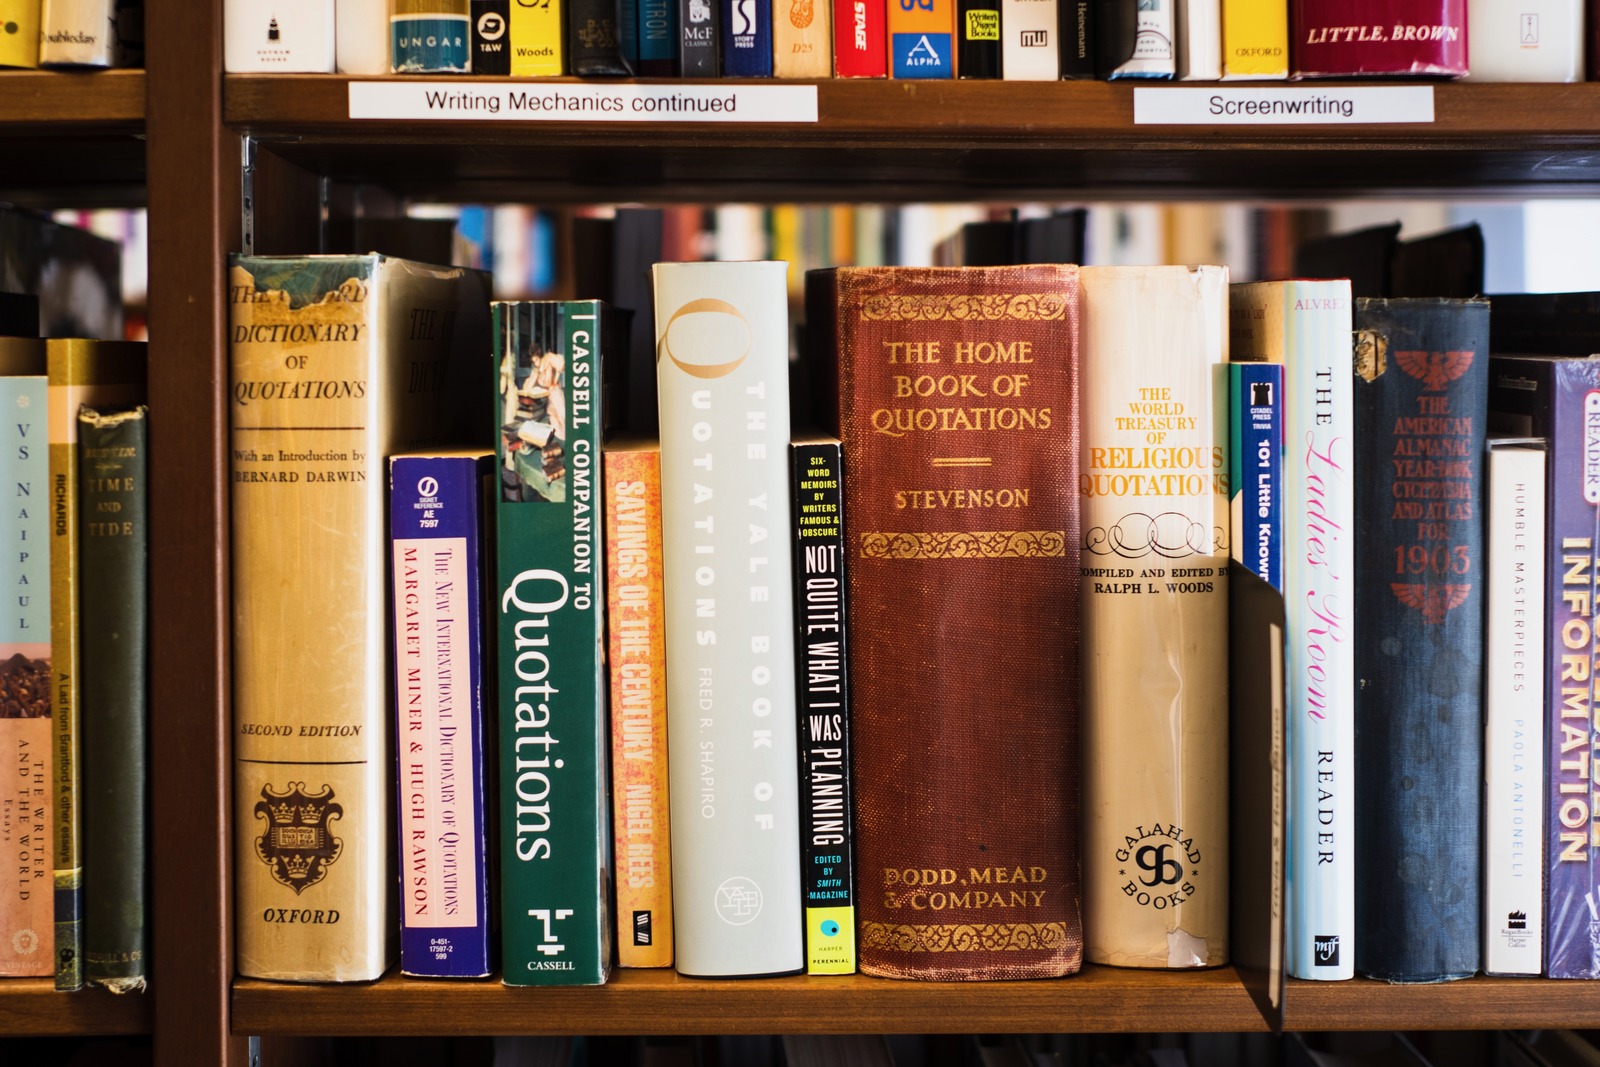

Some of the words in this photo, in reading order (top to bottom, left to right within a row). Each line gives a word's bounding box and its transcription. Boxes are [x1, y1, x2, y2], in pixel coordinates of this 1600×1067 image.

[853, 1, 867, 51] STAGE
[971, 21, 997, 30] Digest
[971, 29, 997, 38] Books
[1078, 2, 1087, 58] Heinemann
[1307, 26, 1388, 45] LITTLE,
[1391, 25, 1459, 42] BROWN
[400, 36, 462, 48] UNGAR
[480, 43, 502, 52] T&W
[516, 47, 554, 57] Woods
[792, 43, 813, 54] D25
[1235, 48, 1282, 57] OXFORD
[906, 58, 941, 66] ALPHA
[425, 91, 500, 113] Writing
[508, 91, 624, 112] Mechanics
[631, 93, 737, 112] continued
[1209, 95, 1354, 117] Screenwriting
[234, 323, 366, 344] DICTIONARY
[285, 355, 308, 370] OF
[883, 341, 941, 364] THE
[955, 341, 1034, 364] HOME
[572, 330, 590, 429] CASSELL
[896, 375, 987, 398] BOOK
[992, 374, 1030, 398] OF
[234, 381, 366, 406] QUOTATIONS
[1138, 387, 1171, 400] THE
[1316, 366, 1332, 425] THE
[1416, 396, 1450, 415] THE
[746, 381, 767, 460] THE
[871, 407, 1052, 437] QUOTATIONS
[1128, 403, 1184, 416] WORLD
[1114, 417, 1198, 430] TREASURY
[1393, 417, 1473, 436] AMERICAN
[1146, 432, 1167, 445] OF
[1393, 438, 1471, 457] ALMANAC
[1588, 411, 1600, 485] READER
[234, 450, 258, 462] With
[262, 453, 274, 462] an
[279, 450, 348, 462] Introduction
[353, 450, 366, 464] by
[810, 456, 826, 466] SIX-
[1089, 446, 1224, 469] RELIGIOUS
[1258, 438, 1271, 468] 101
[88, 477, 135, 493] TIME
[234, 471, 299, 483] BERNARD
[306, 471, 366, 483] DARWIN
[801, 480, 837, 489] MEMOIRS
[807, 468, 830, 477] WORD
[1079, 473, 1230, 497] QUOTATIONS
[55, 473, 67, 537] RICHARDS
[96, 501, 121, 513] AND
[572, 438, 591, 574] COMPANION
[802, 504, 837, 513] WRITERS
[814, 492, 824, 501] BY
[896, 488, 1030, 510] STEVENSON
[1258, 474, 1271, 518] Little
[1305, 431, 1350, 580] Ladies'
[419, 519, 439, 528] 7597
[423, 510, 435, 518] AE
[800, 516, 831, 525] FAMOUS
[833, 515, 840, 525] &
[1392, 502, 1423, 520] AND
[1424, 502, 1472, 520] ATLAS
[1514, 483, 1525, 552] HUMBLE
[88, 522, 133, 536] TIDE
[616, 480, 648, 579] SAYINGS
[802, 528, 838, 537] OBSCURE
[1416, 523, 1449, 541] FOR
[17, 482, 31, 630] NAIPAUL
[748, 492, 770, 602] YALE
[805, 545, 837, 574] NOT
[1394, 545, 1471, 575] 1903
[435, 548, 453, 575] THE
[1140, 568, 1165, 578] AND
[1171, 567, 1214, 578] EDITED
[436, 581, 455, 611] NEW
[573, 583, 591, 610] TO
[618, 584, 649, 611] OF
[1094, 583, 1142, 594] RALPH
[1148, 583, 1160, 594] L.
[1166, 582, 1214, 594] WOODS
[404, 547, 421, 656] MARGARET
[806, 578, 839, 635] QUITE
[620, 616, 651, 657] THE
[1514, 562, 1525, 693] MASTERPIECES
[437, 618, 455, 722] INTERNATIONAL
[808, 641, 840, 694] WHAT
[1306, 590, 1350, 725] Room
[59, 673, 69, 682] A
[699, 667, 713, 711] FRED
[59, 682, 69, 700] Lad
[408, 668, 423, 732] MINER
[750, 635, 773, 750] BOOK
[1559, 536, 1591, 862] INFORMATION
[59, 702, 70, 731] from
[502, 568, 570, 862] Quotations
[621, 663, 653, 762] CENTURY
[700, 717, 714, 734] R.
[241, 723, 293, 737] SECOND
[298, 725, 362, 737] EDITION
[809, 714, 842, 741] WAS
[18, 739, 29, 777] AND
[59, 733, 71, 783] Brantford
[410, 741, 423, 753] &
[1513, 719, 1524, 773] PAOLA
[33, 760, 44, 797] THE
[439, 726, 457, 805] DICTIONARY
[60, 784, 71, 794] &
[410, 764, 425, 820] HUGH
[700, 742, 715, 819] SHAPIRO
[19, 794, 30, 824] THE
[754, 781, 774, 831] OF
[811, 747, 844, 846] PLANNING
[1317, 749, 1334, 866] READER
[4, 799, 13, 842] Essays
[60, 796, 71, 824] other
[442, 810, 456, 827] OF
[626, 783, 653, 837] NIGEL
[34, 807, 44, 879] WRITER
[1512, 782, 1524, 878] ANTONELLI
[60, 826, 70, 864] essays
[1115, 823, 1201, 865] GALAHAD
[19, 834, 30, 901] WORLD
[413, 829, 427, 916] RAWSON
[628, 843, 654, 889] REES
[814, 855, 842, 864] EDITED
[823, 867, 833, 876] BY
[439, 832, 461, 916] QUOTATIONS
[816, 879, 842, 888] SMITH
[883, 867, 967, 887] DODD,
[970, 866, 1047, 885] MEAD
[809, 890, 849, 900] MAGAZINE
[911, 890, 1046, 910] COMPANY
[1121, 880, 1195, 910] BOOKS
[263, 908, 341, 924] OXFORD
[429, 945, 453, 953] 17597-2
[527, 960, 576, 971] CASSELL
